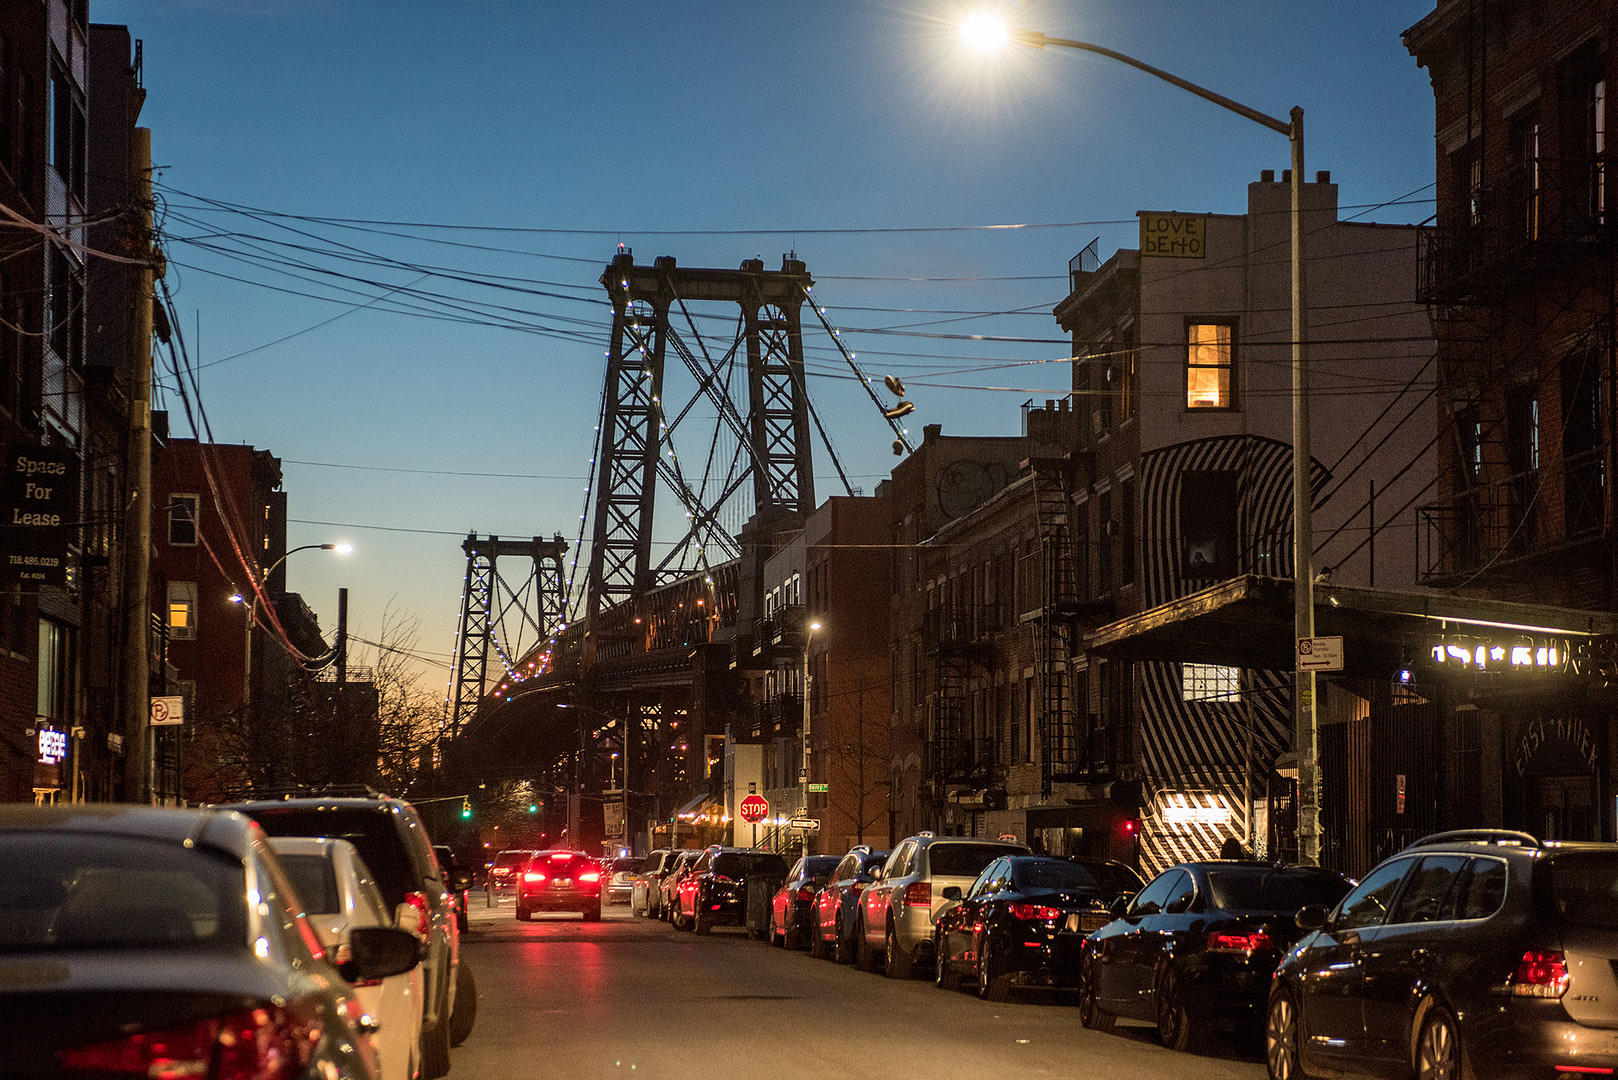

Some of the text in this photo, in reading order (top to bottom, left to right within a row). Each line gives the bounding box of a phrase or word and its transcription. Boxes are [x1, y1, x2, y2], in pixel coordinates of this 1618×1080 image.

[1145, 217, 1196, 234] LOVE
[16, 456, 66, 477] Space
[25, 482, 53, 500] For
[12, 508, 61, 527] Lease
[741, 803, 767, 815] STOP
